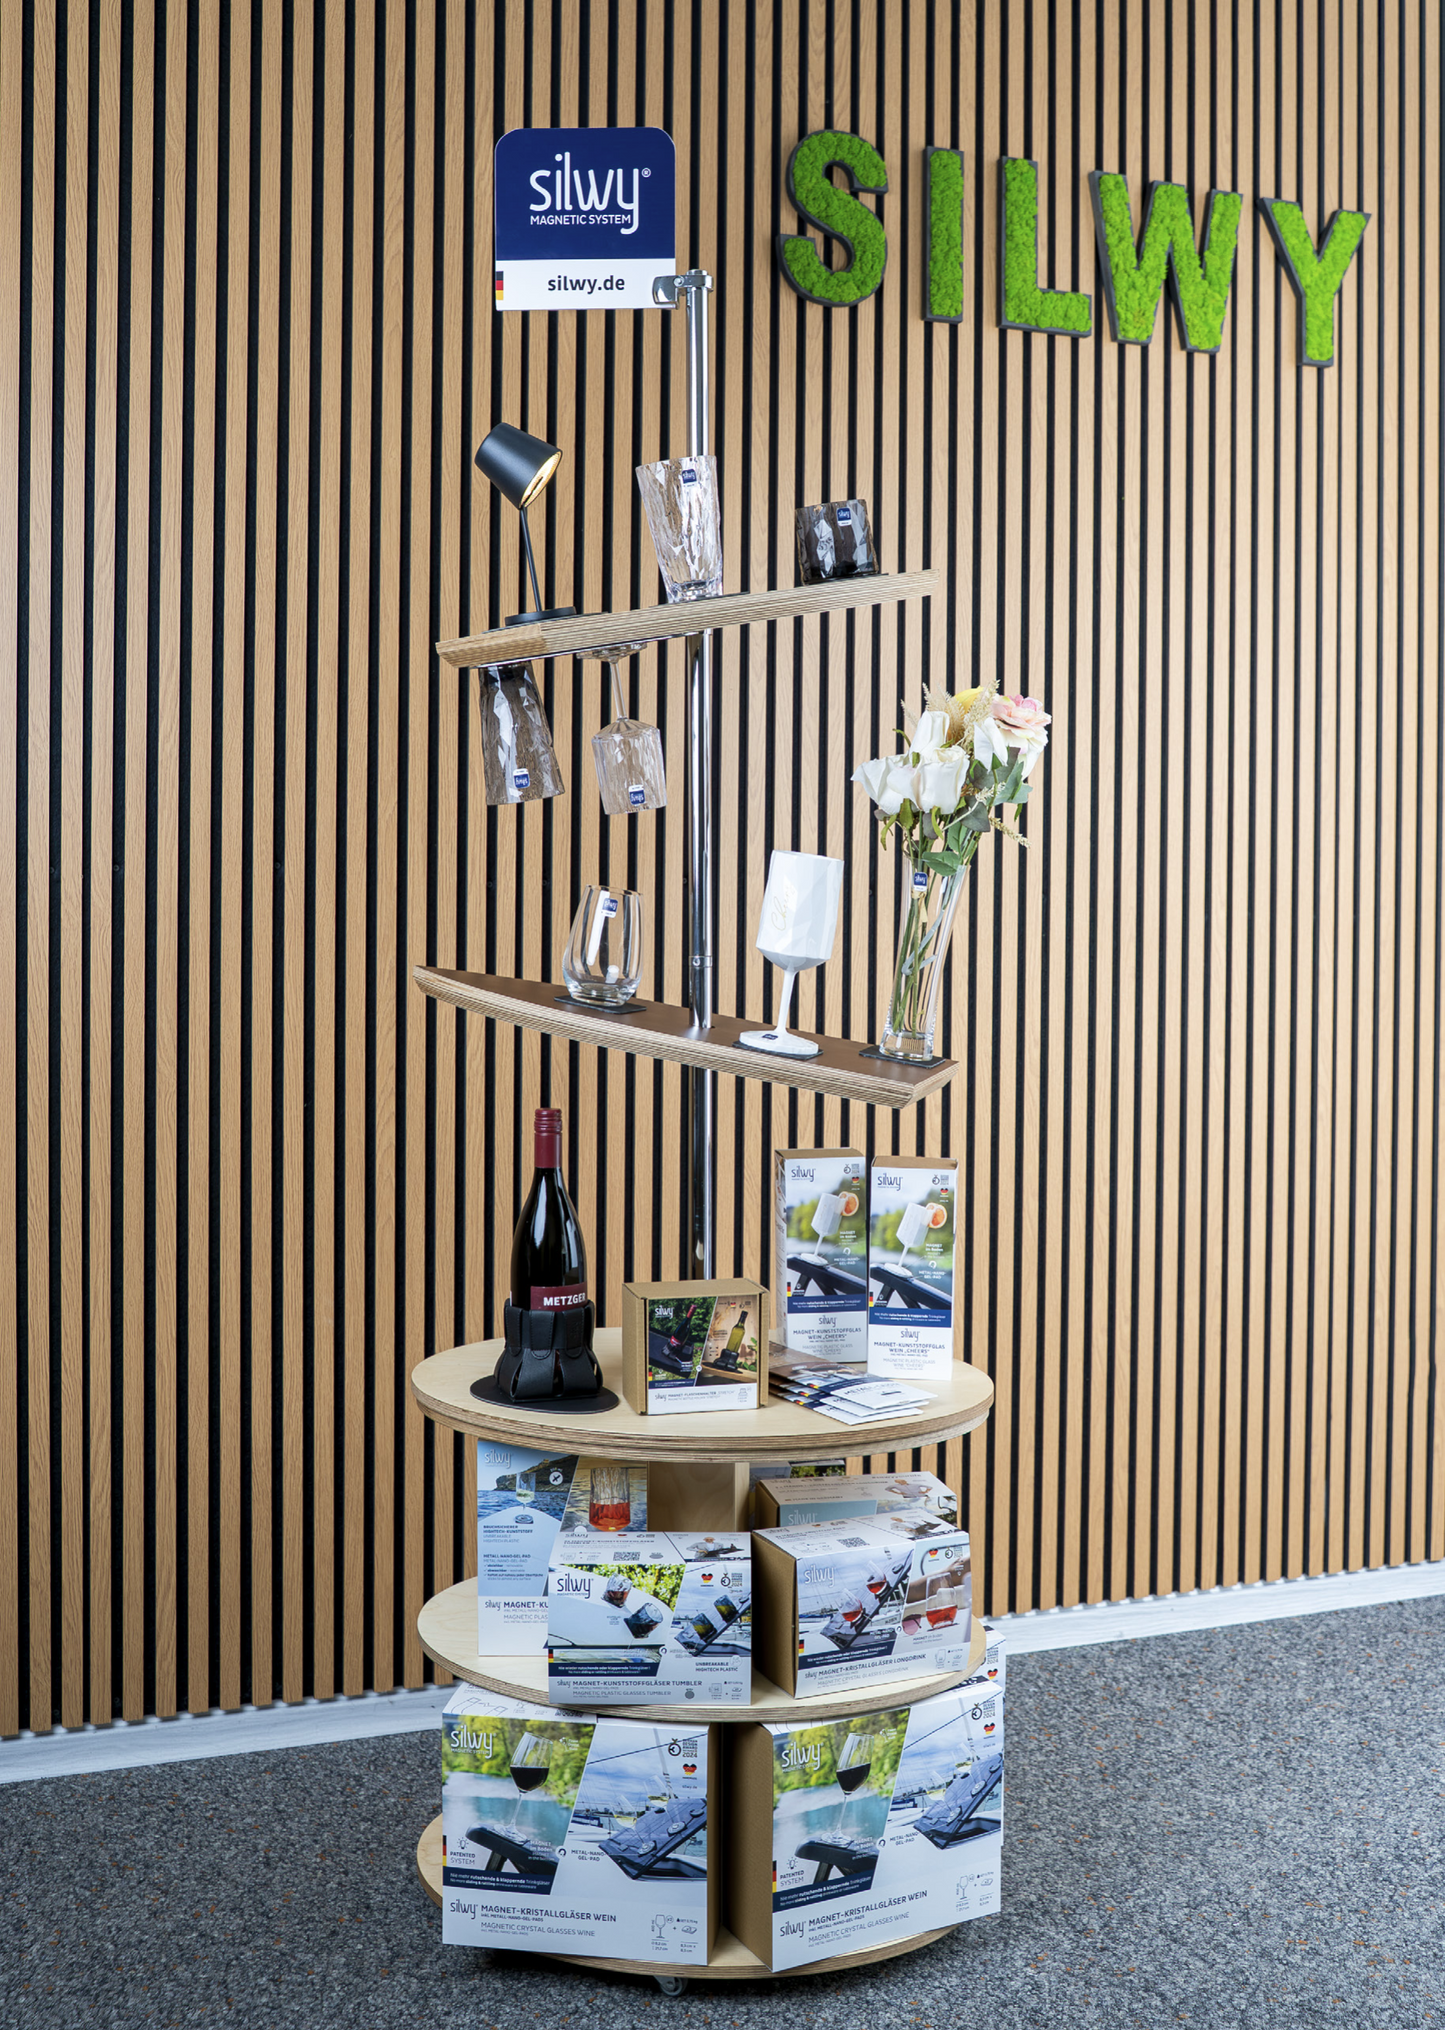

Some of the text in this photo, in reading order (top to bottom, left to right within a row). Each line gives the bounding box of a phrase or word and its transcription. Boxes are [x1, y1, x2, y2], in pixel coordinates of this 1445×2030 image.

[530, 214, 631, 226] MAGNETIC SYSTEM
[776, 129, 1372, 368] SILWY
[547, 275, 625, 294] silwy.de
[791, 1165, 816, 1182] silwy
[877, 1173, 903, 1191] silwy
[543, 1292, 586, 1307] METZGER
[655, 1305, 674, 1319] silwy
[818, 1315, 837, 1328] silwy
[900, 1328, 920, 1342] silwy
[484, 1449, 511, 1469] silwy
[804, 1564, 835, 1588] silwy
[557, 1573, 592, 1599] silwy
[485, 1599, 501, 1611] silwy
[450, 1724, 494, 1759] silwy
[781, 1741, 820, 1771] silwy
[450, 1851, 476, 1859] PATENTED
[450, 1857, 475, 1865] SYSTEM
[780, 1870, 804, 1880] PATENTED
[780, 1877, 804, 1887] SYSTEM
[450, 1898, 477, 1920] silwy
[481, 1904, 617, 1922] MAGNET-KRISTALLGLÄSER WEIN
[808, 1890, 928, 1927] MAGNET-KRISTALLGLÄSER WEIN
[481, 1922, 595, 1937] MAGNETIC CRYSTAL GLASSES WINE
[780, 1921, 804, 1938] silwy
[808, 1911, 910, 1943] MAGNETIC CRYSTAL GLASSES WINE
